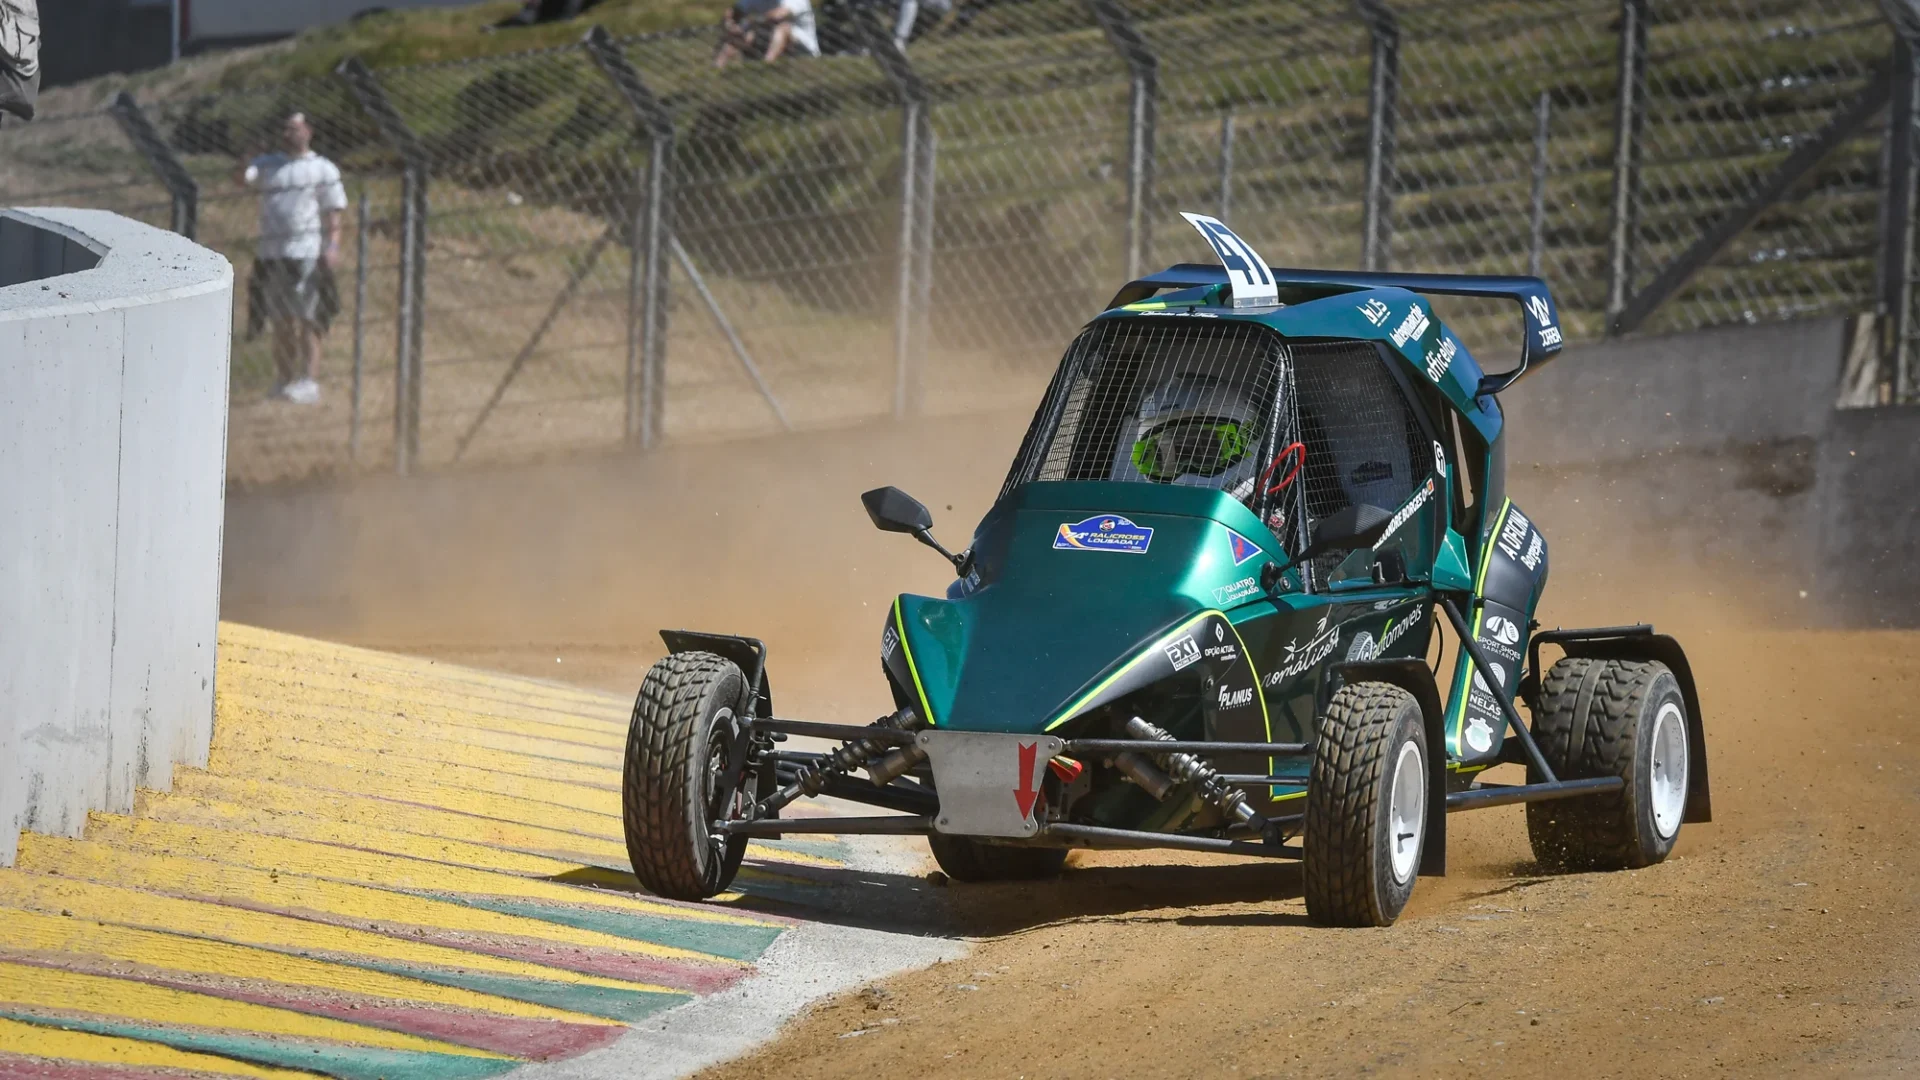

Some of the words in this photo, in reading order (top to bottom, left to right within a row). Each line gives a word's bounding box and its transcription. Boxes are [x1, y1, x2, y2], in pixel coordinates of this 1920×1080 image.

[1195, 220, 1270, 285] 47
[1402, 492, 1423, 522] BORGES
[1090, 532, 1145, 541] RALICROSS
[1502, 508, 1529, 550] OFICINA
[1087, 538, 1133, 546] LOUSADA
[1498, 541, 1518, 561] A
[1225, 577, 1255, 592] QUATRO
[1220, 645, 1235, 655] ACTUAL
[1478, 636, 1501, 651] SPORT
[1500, 645, 1521, 660] SHOES
[1482, 644, 1515, 661] SAPATARIA
[1470, 695, 1502, 716] NELAS
